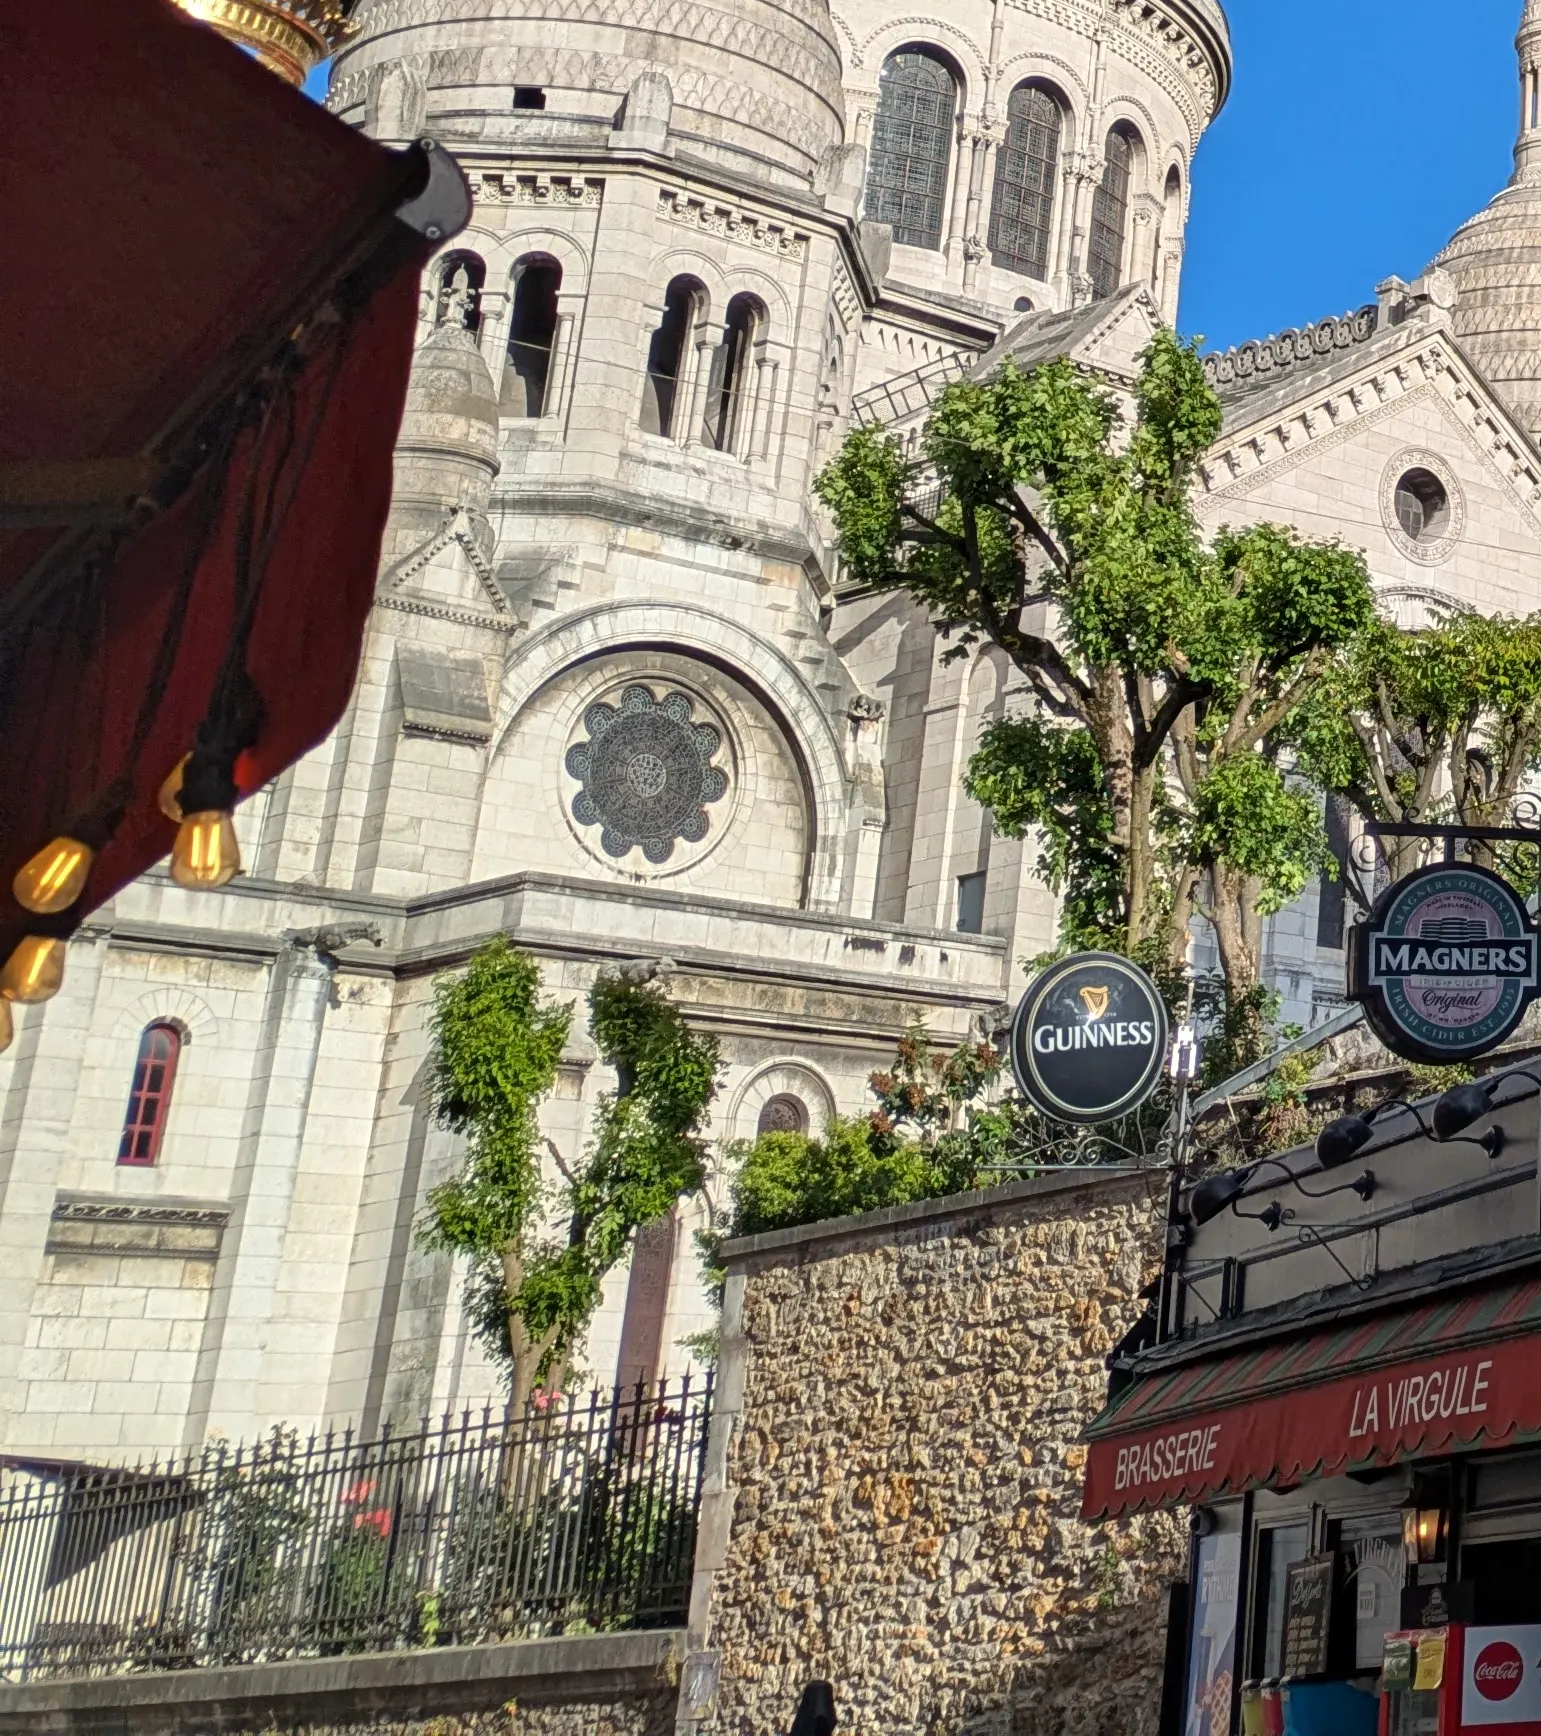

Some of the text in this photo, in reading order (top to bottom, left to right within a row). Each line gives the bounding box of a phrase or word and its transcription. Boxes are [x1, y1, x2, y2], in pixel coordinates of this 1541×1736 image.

[1394, 878, 1514, 929] MAGNERS ORIGINAL
[1380, 944, 1527, 972] MAGNERS
[1391, 988, 1420, 1026] IRISH
[1422, 1023, 1465, 1041] CIDER
[1422, 989, 1483, 1013] Original
[1034, 1021, 1153, 1053] GUINNESS
[1115, 1361, 1492, 1490] BRASSERIE LA VIRGULE
